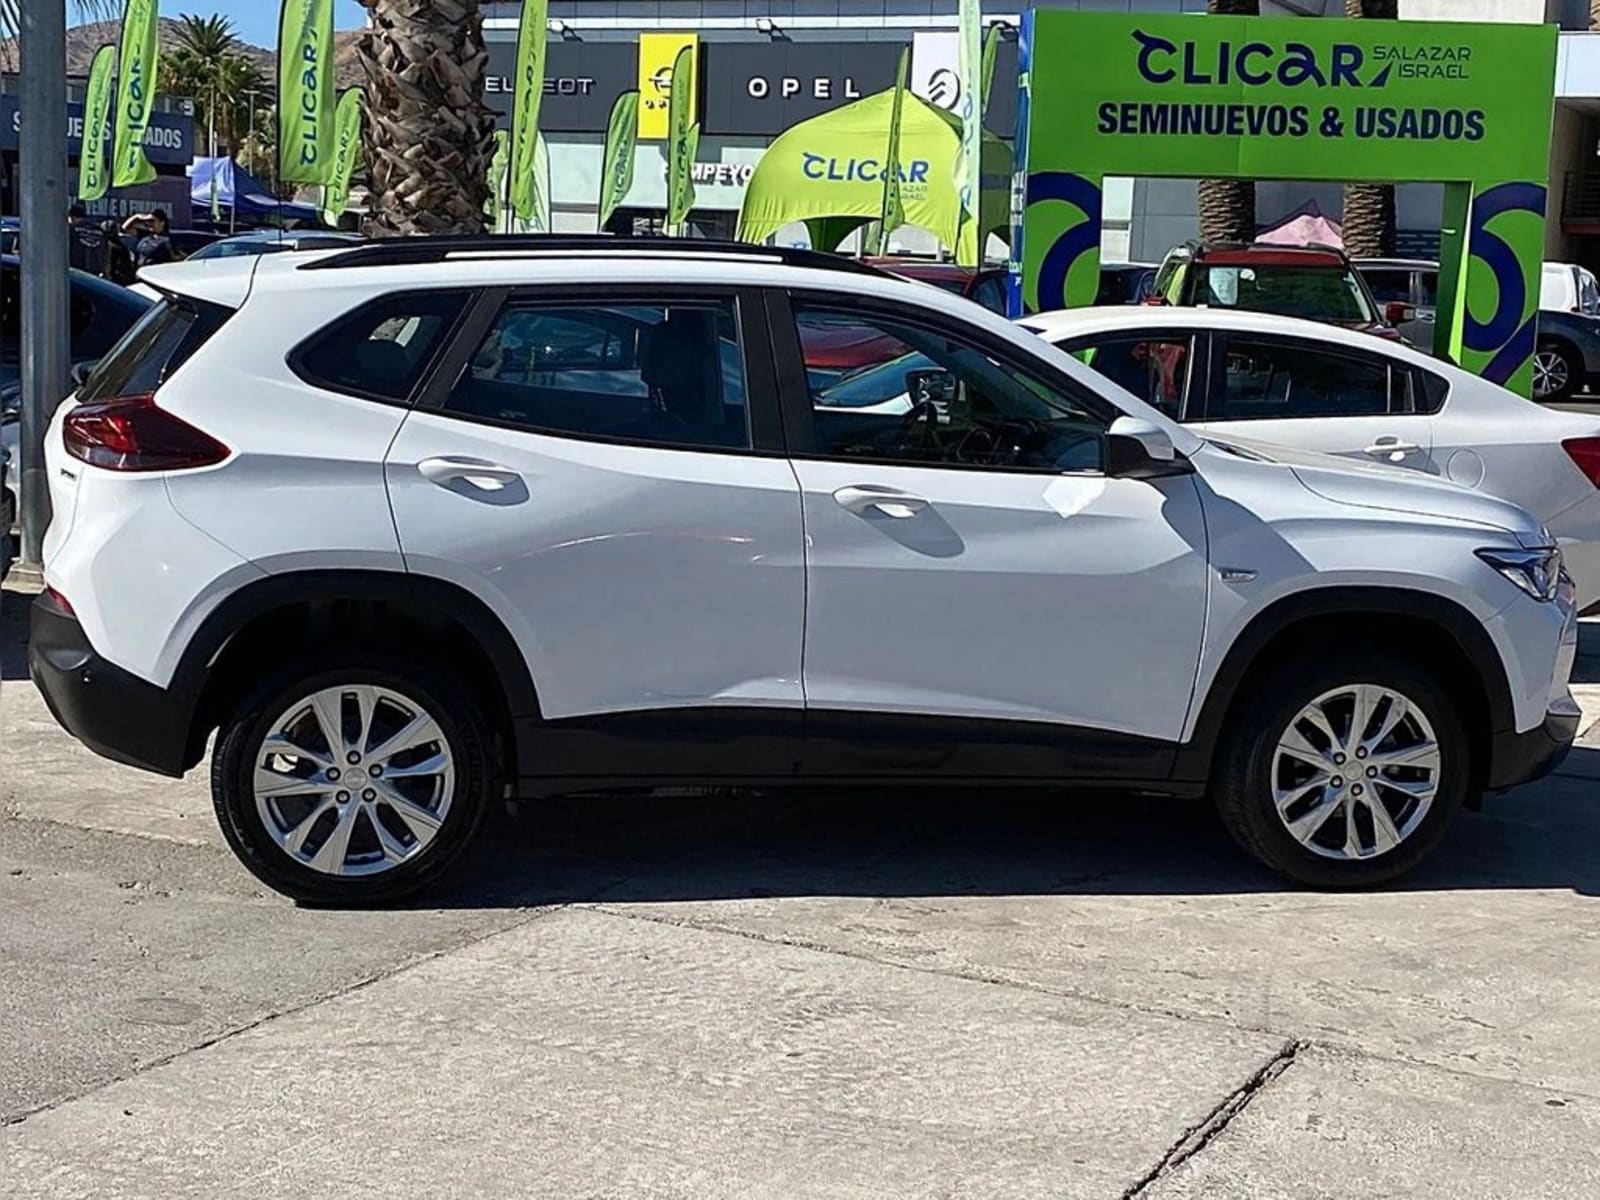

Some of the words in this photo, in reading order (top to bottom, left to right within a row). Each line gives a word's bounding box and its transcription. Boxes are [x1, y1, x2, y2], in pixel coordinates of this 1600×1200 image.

[1373, 45, 1472, 62] SALAZAR
[1398, 63, 1470, 79] ISRAEL
[749, 78, 860, 97] OPEL
[1098, 102, 1309, 137] SEMINUEVOS
[1319, 105, 1344, 137] &
[1355, 107, 1486, 141] USADOS
